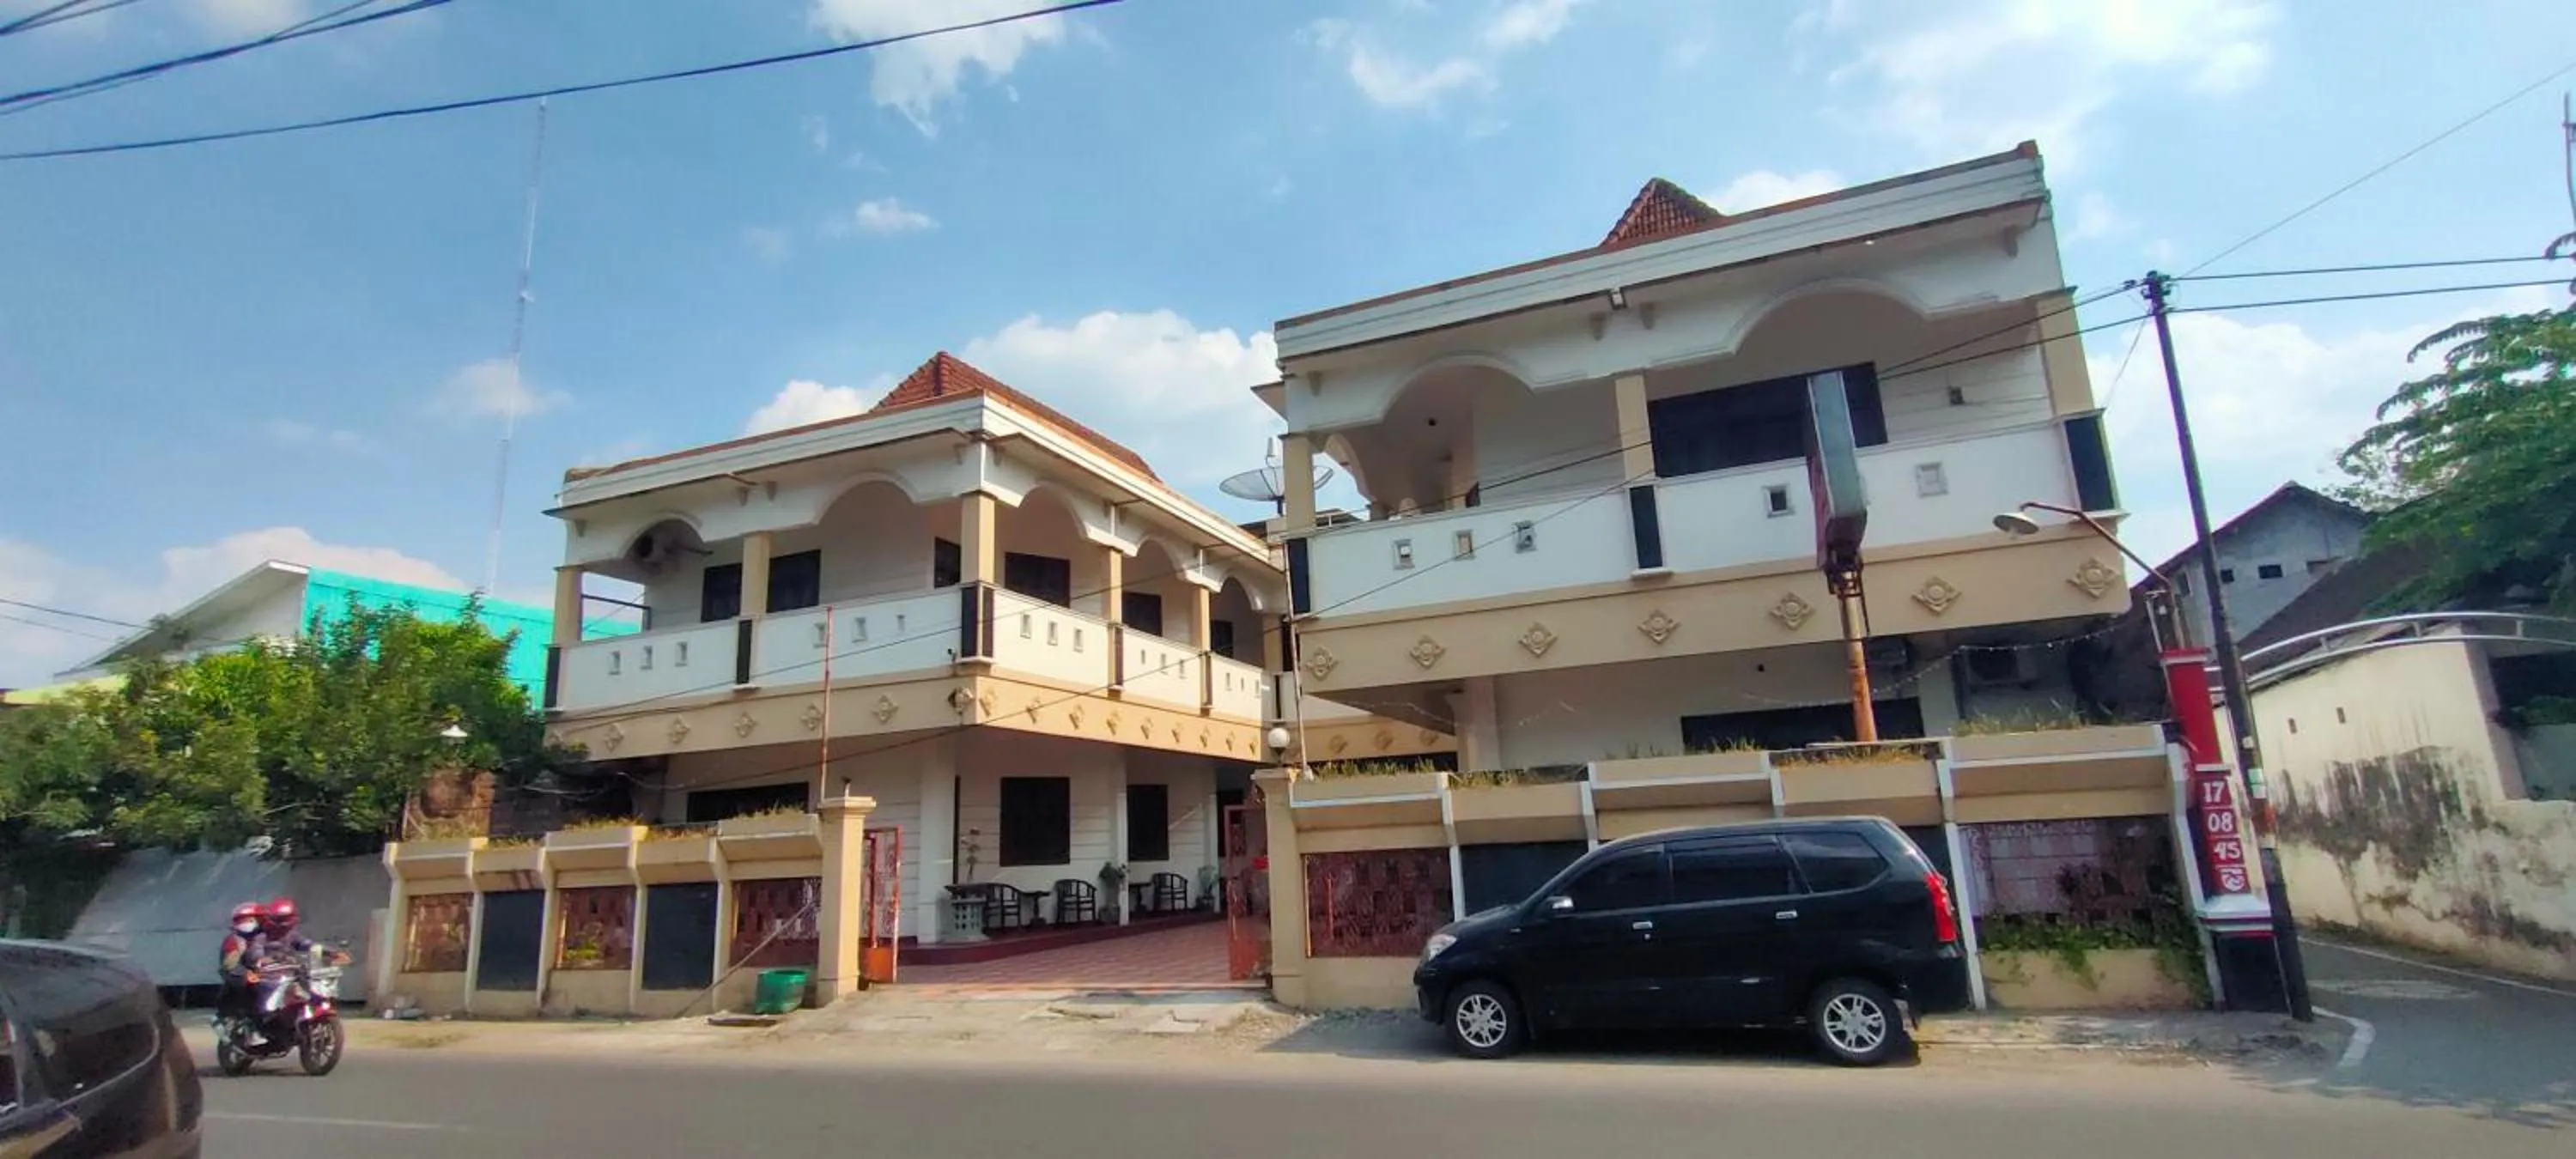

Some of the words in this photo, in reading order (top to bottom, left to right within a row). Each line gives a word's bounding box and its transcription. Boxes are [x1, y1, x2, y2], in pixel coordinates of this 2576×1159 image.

[2203, 780, 2225, 803] 17
[2208, 812, 2233, 833] 08
[2214, 841, 2240, 860] 45
